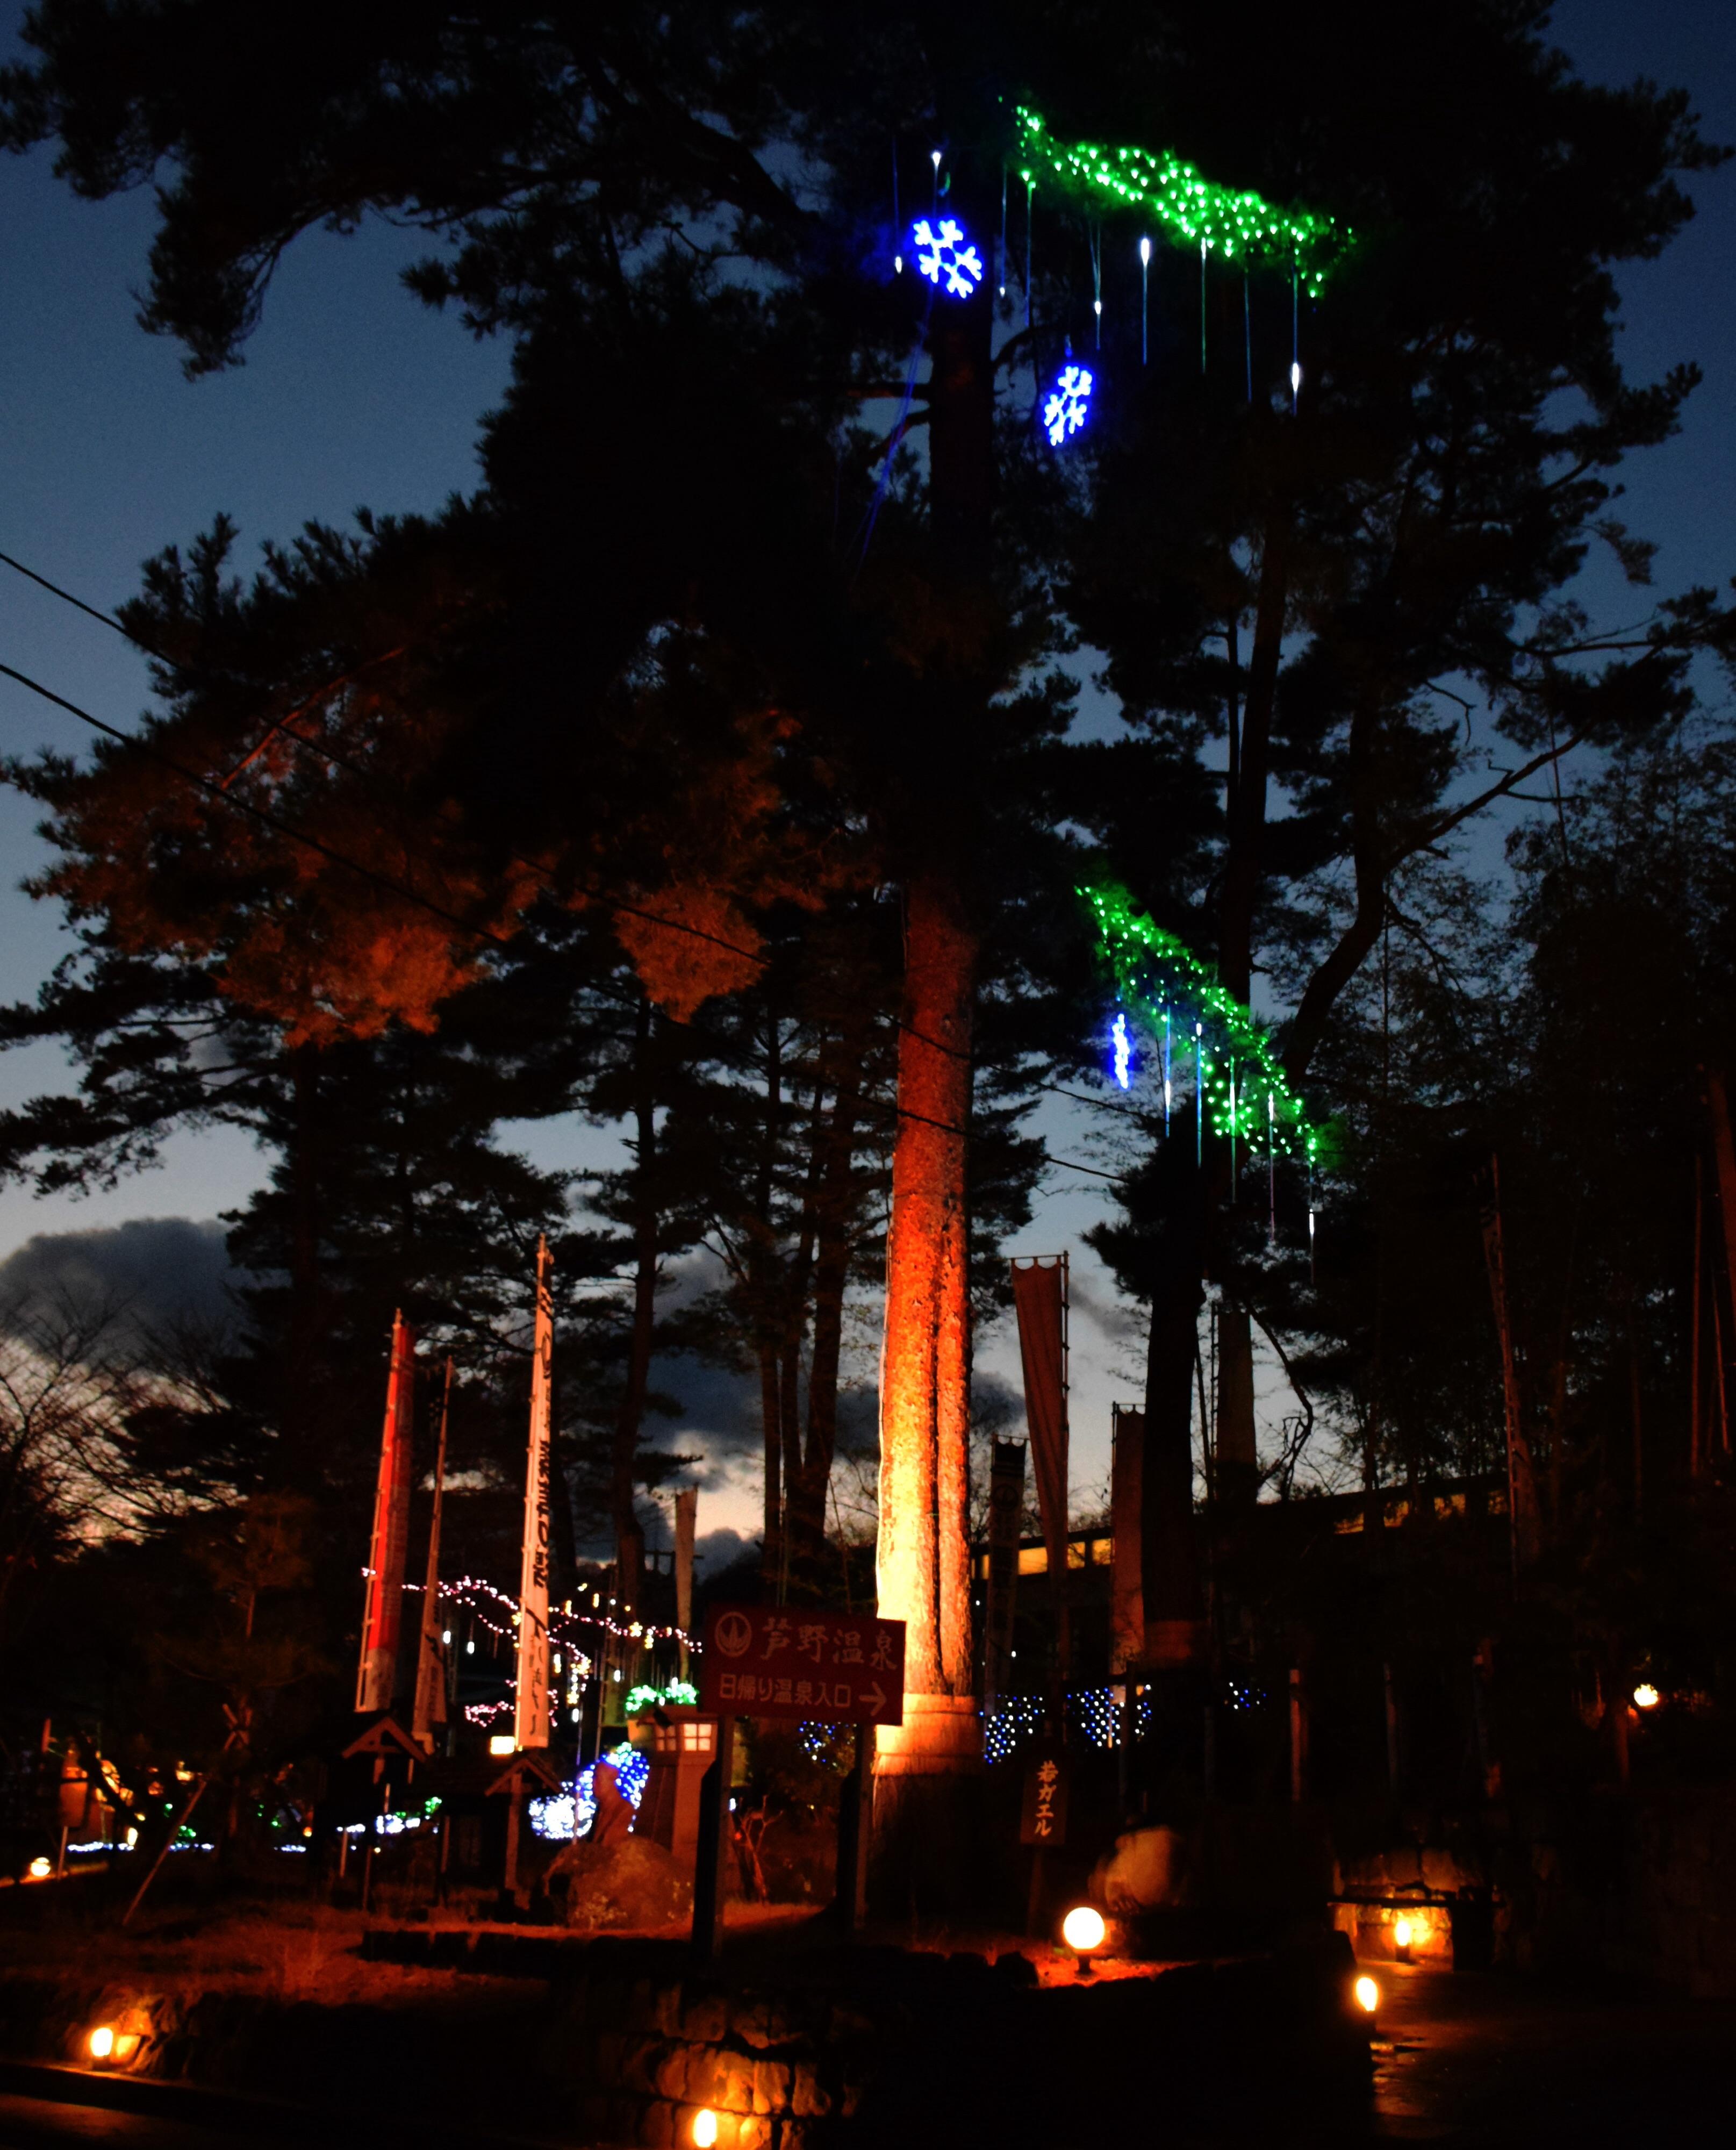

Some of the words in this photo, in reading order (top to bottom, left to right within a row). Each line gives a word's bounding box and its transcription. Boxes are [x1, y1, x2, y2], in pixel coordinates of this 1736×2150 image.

[759, 1617, 898, 1671] 芦野温泉
[719, 1673, 852, 1709] 日帰り温泉入口
[1034, 1759, 1060, 1837] 若ガエル
